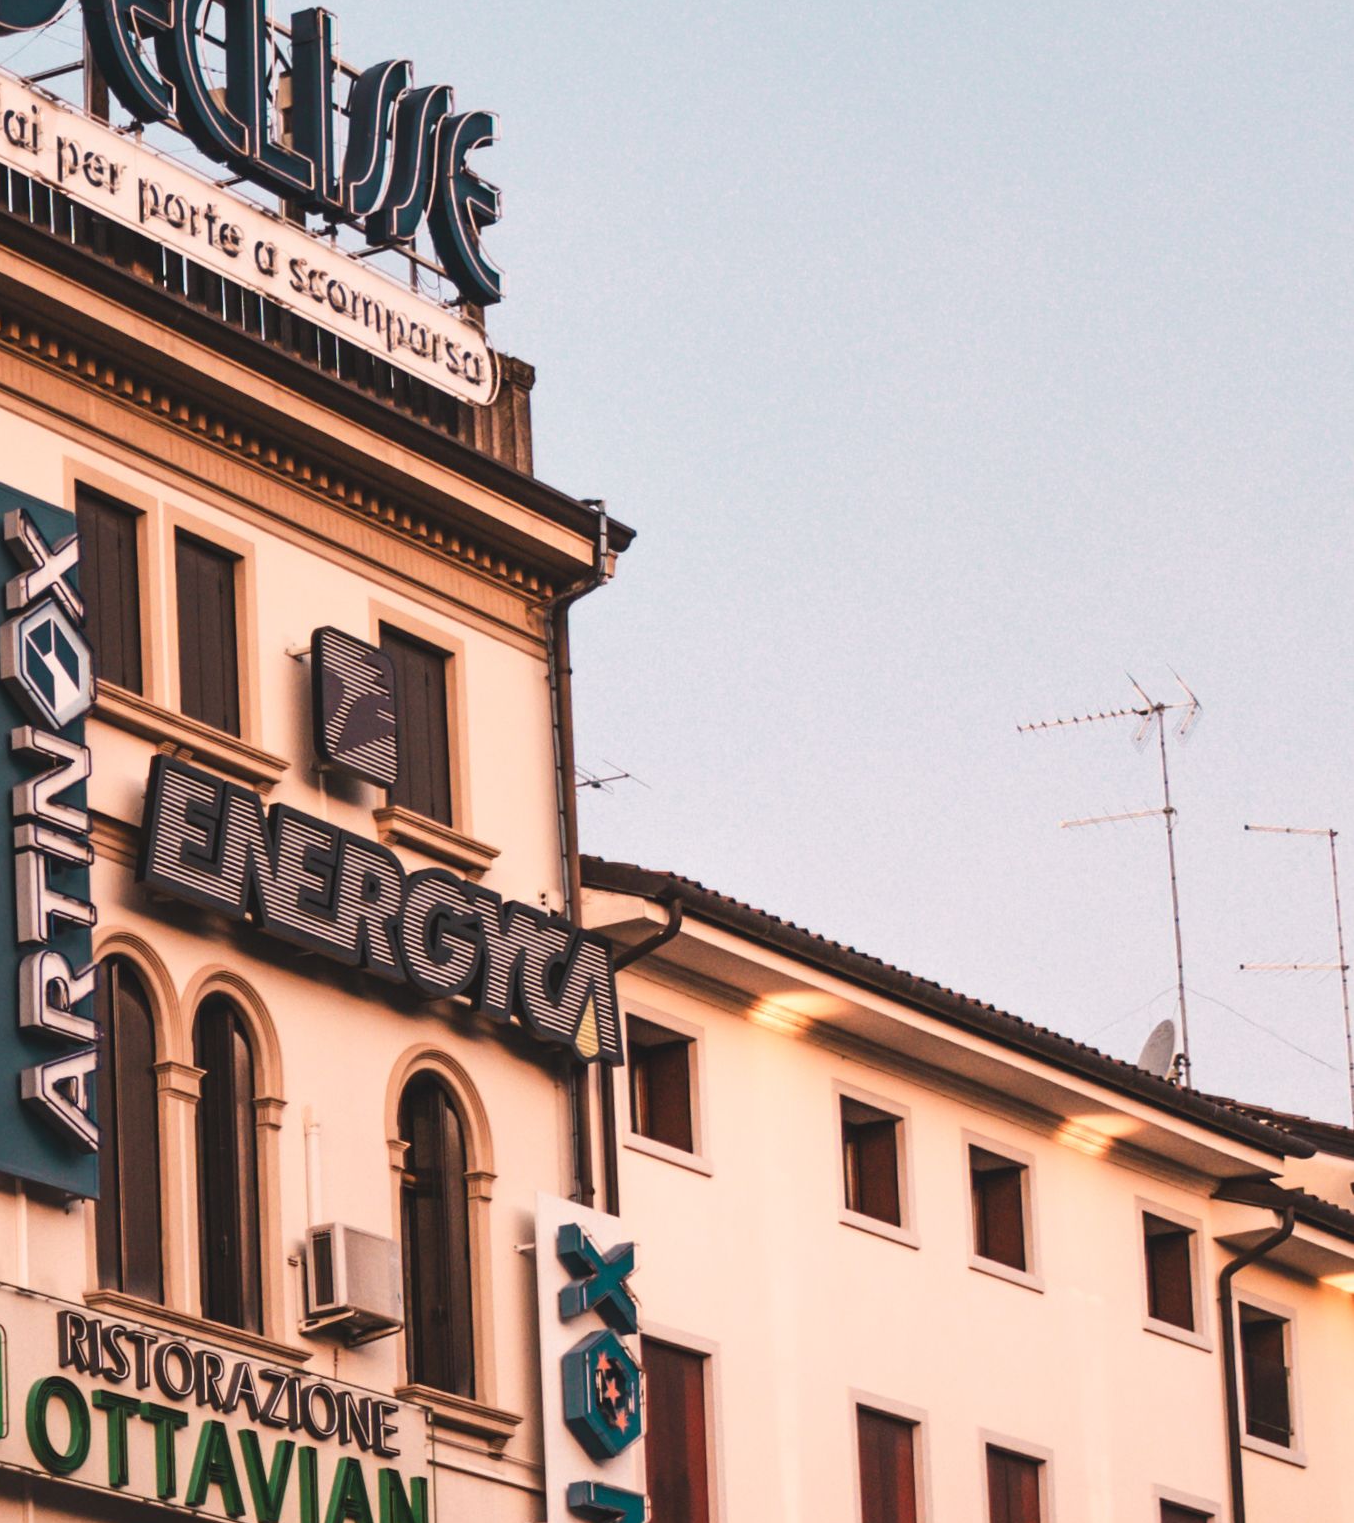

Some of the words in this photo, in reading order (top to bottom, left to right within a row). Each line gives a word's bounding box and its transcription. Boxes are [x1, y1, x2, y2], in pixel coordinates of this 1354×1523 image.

[56, 135, 128, 196] per
[138, 176, 244, 257] porte
[254, 240, 280, 277] a
[289, 256, 487, 386] scomparsa
[57, 1309, 402, 1458] RISTORAZIONE
